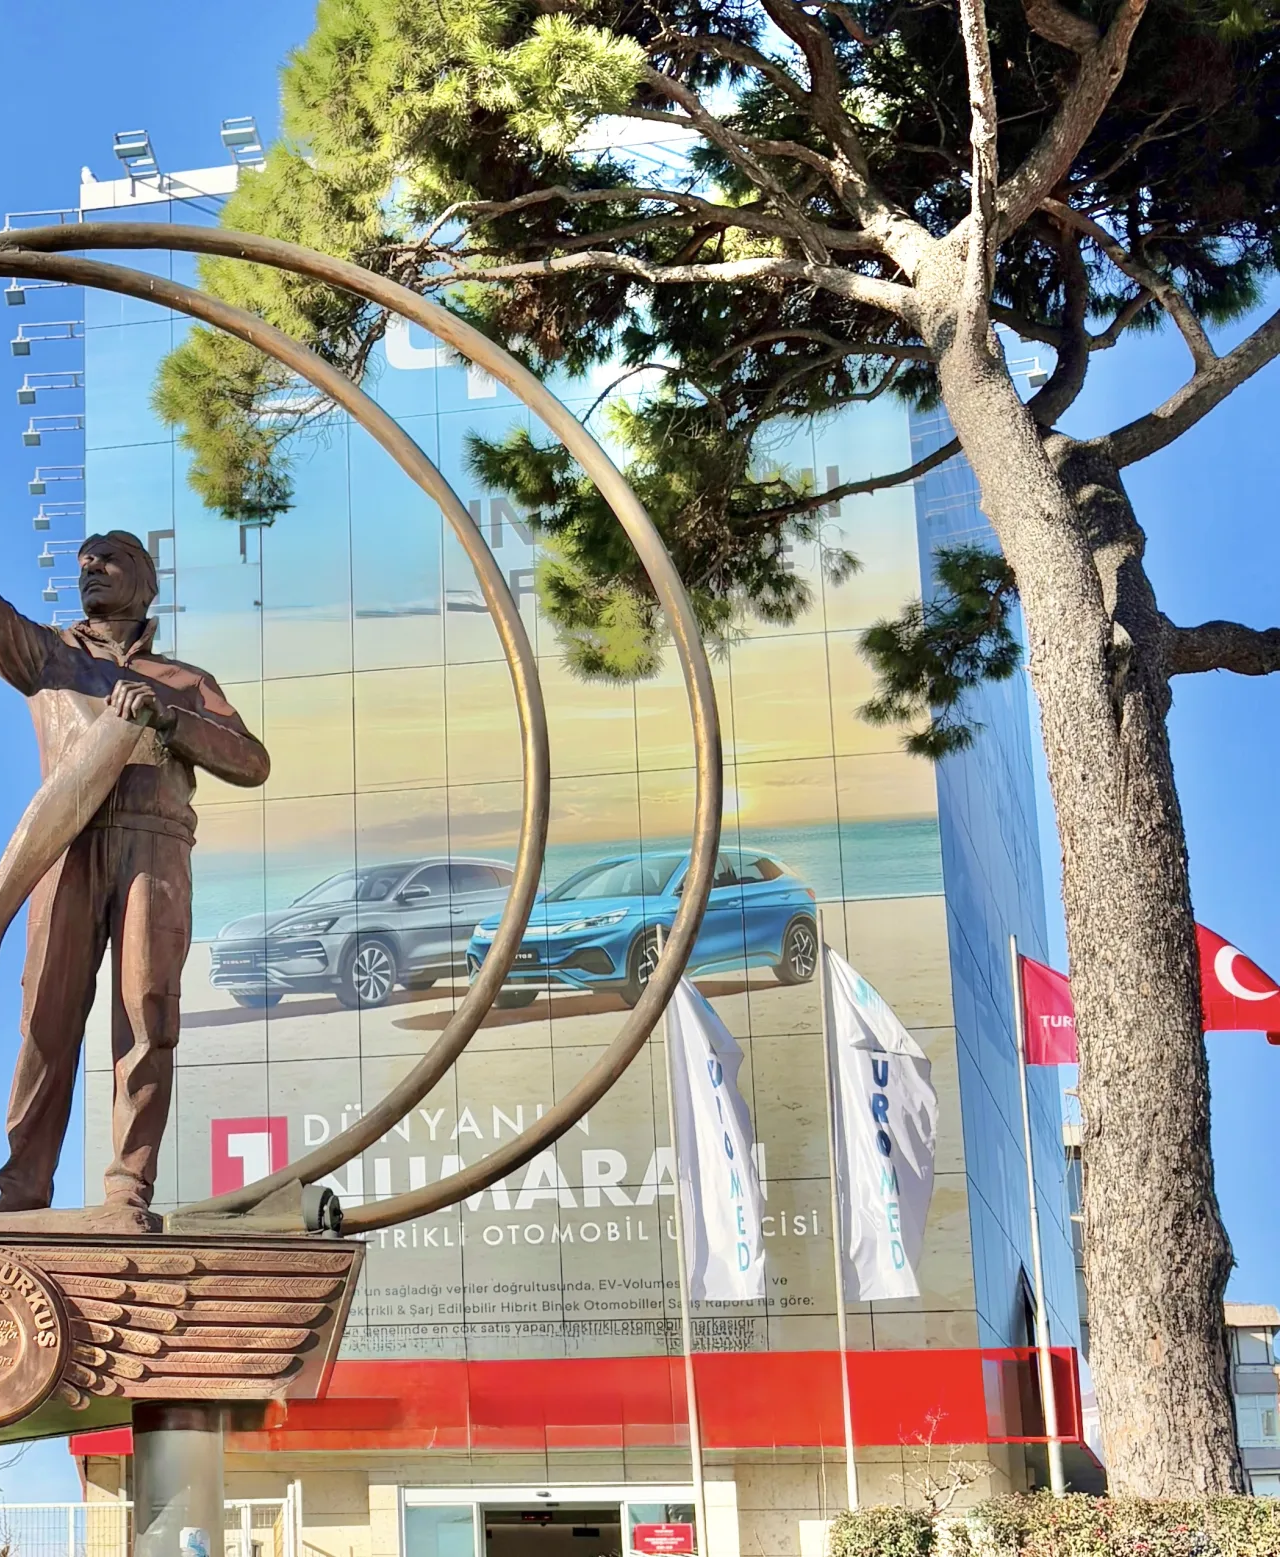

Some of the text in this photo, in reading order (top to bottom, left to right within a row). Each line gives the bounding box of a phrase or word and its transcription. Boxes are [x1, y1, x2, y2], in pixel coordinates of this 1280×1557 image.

[1040, 1014, 1073, 1028] TUR
[871, 1049, 905, 1270] UROMED
[483, 1216, 649, 1246] OTOMOBİL
[384, 1284, 442, 1298] sağladığı
[446, 1283, 488, 1295] veriler
[771, 1276, 788, 1286] ve
[397, 1305, 406, 1315] &
[409, 1303, 434, 1318] Şarj
[438, 1301, 497, 1315] Edilebilir
[500, 1300, 538, 1314] Hibrit
[542, 1299, 580, 1312] Binek
[583, 1298, 663, 1311] Otomobiller
[668, 1298, 701, 1311] Saış
[432, 1326, 448, 1335] en
[452, 1322, 476, 1336] çok
[481, 1322, 511, 1335] satış
[515, 1322, 554, 1336] yapan
